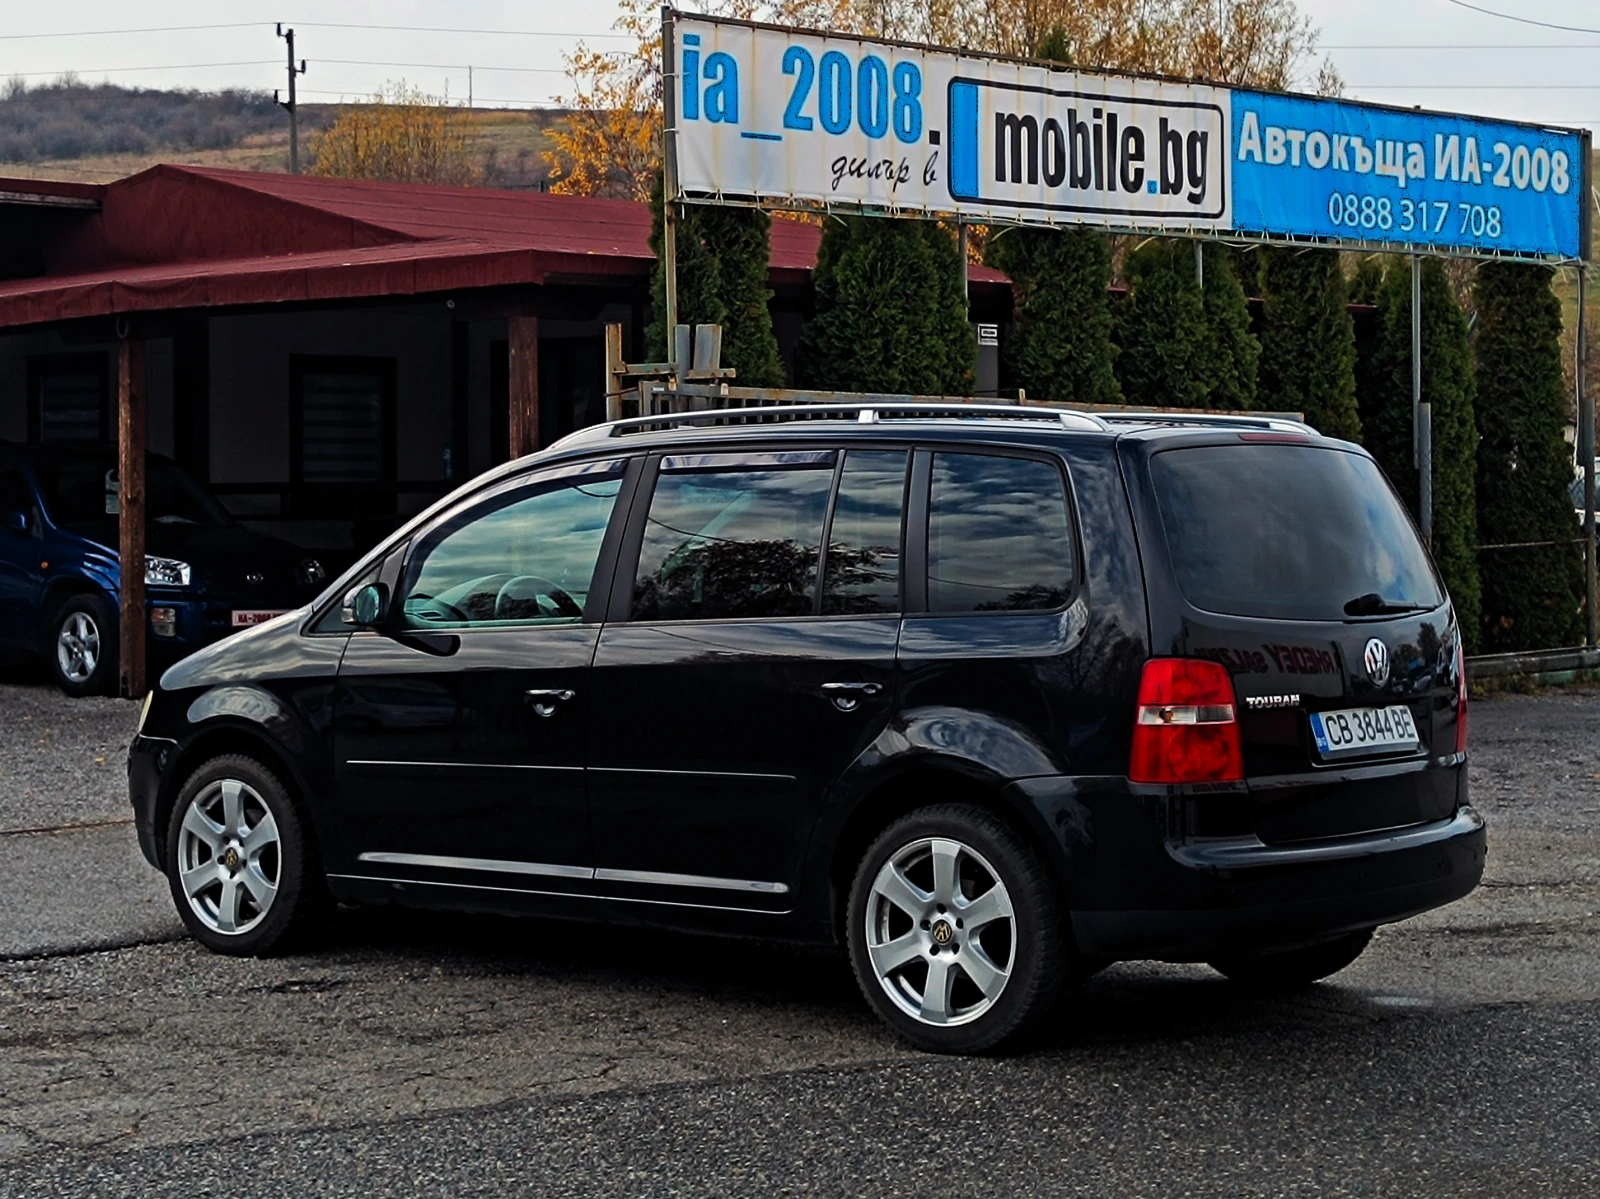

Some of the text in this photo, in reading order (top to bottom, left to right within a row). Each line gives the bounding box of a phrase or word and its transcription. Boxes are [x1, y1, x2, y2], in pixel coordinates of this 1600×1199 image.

[995, 107, 1208, 205] mobile.bg
[1237, 111, 1570, 194] Автокъща ИА-2008
[1329, 192, 1501, 238] 0888 317 708
[1245, 694, 1300, 709] TOURAN
[1325, 708, 1415, 746] CB 3844 BE
